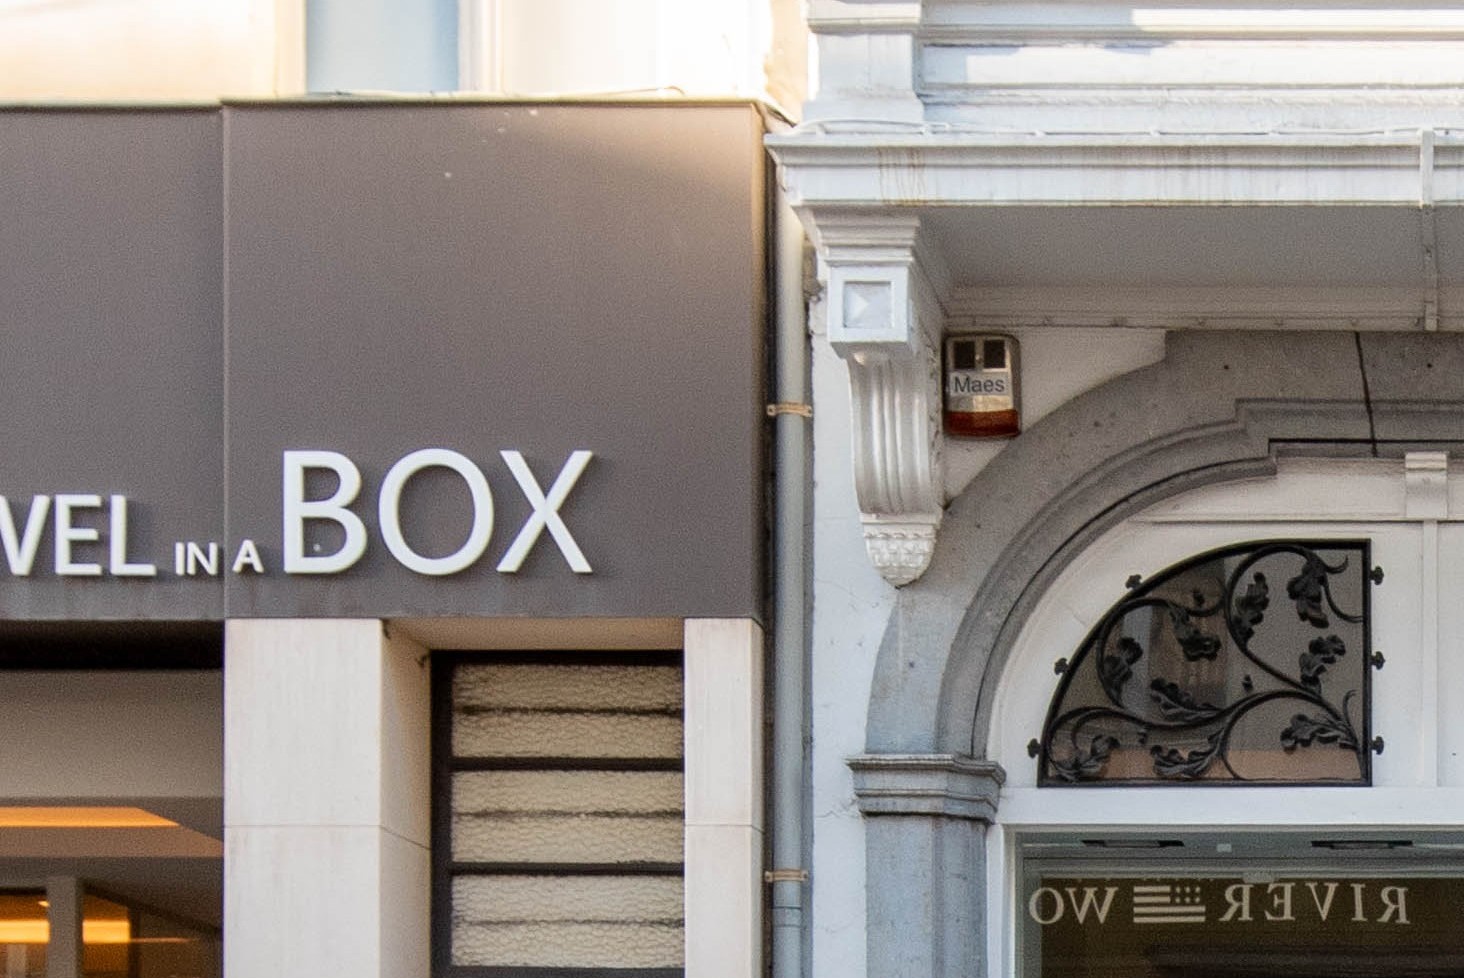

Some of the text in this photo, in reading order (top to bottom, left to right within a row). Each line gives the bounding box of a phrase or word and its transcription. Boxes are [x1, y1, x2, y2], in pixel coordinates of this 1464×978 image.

[954, 375, 1005, 393] Maes
[175, 541, 219, 575] IN
[232, 539, 264, 573] A
[283, 448, 593, 575] BOX
